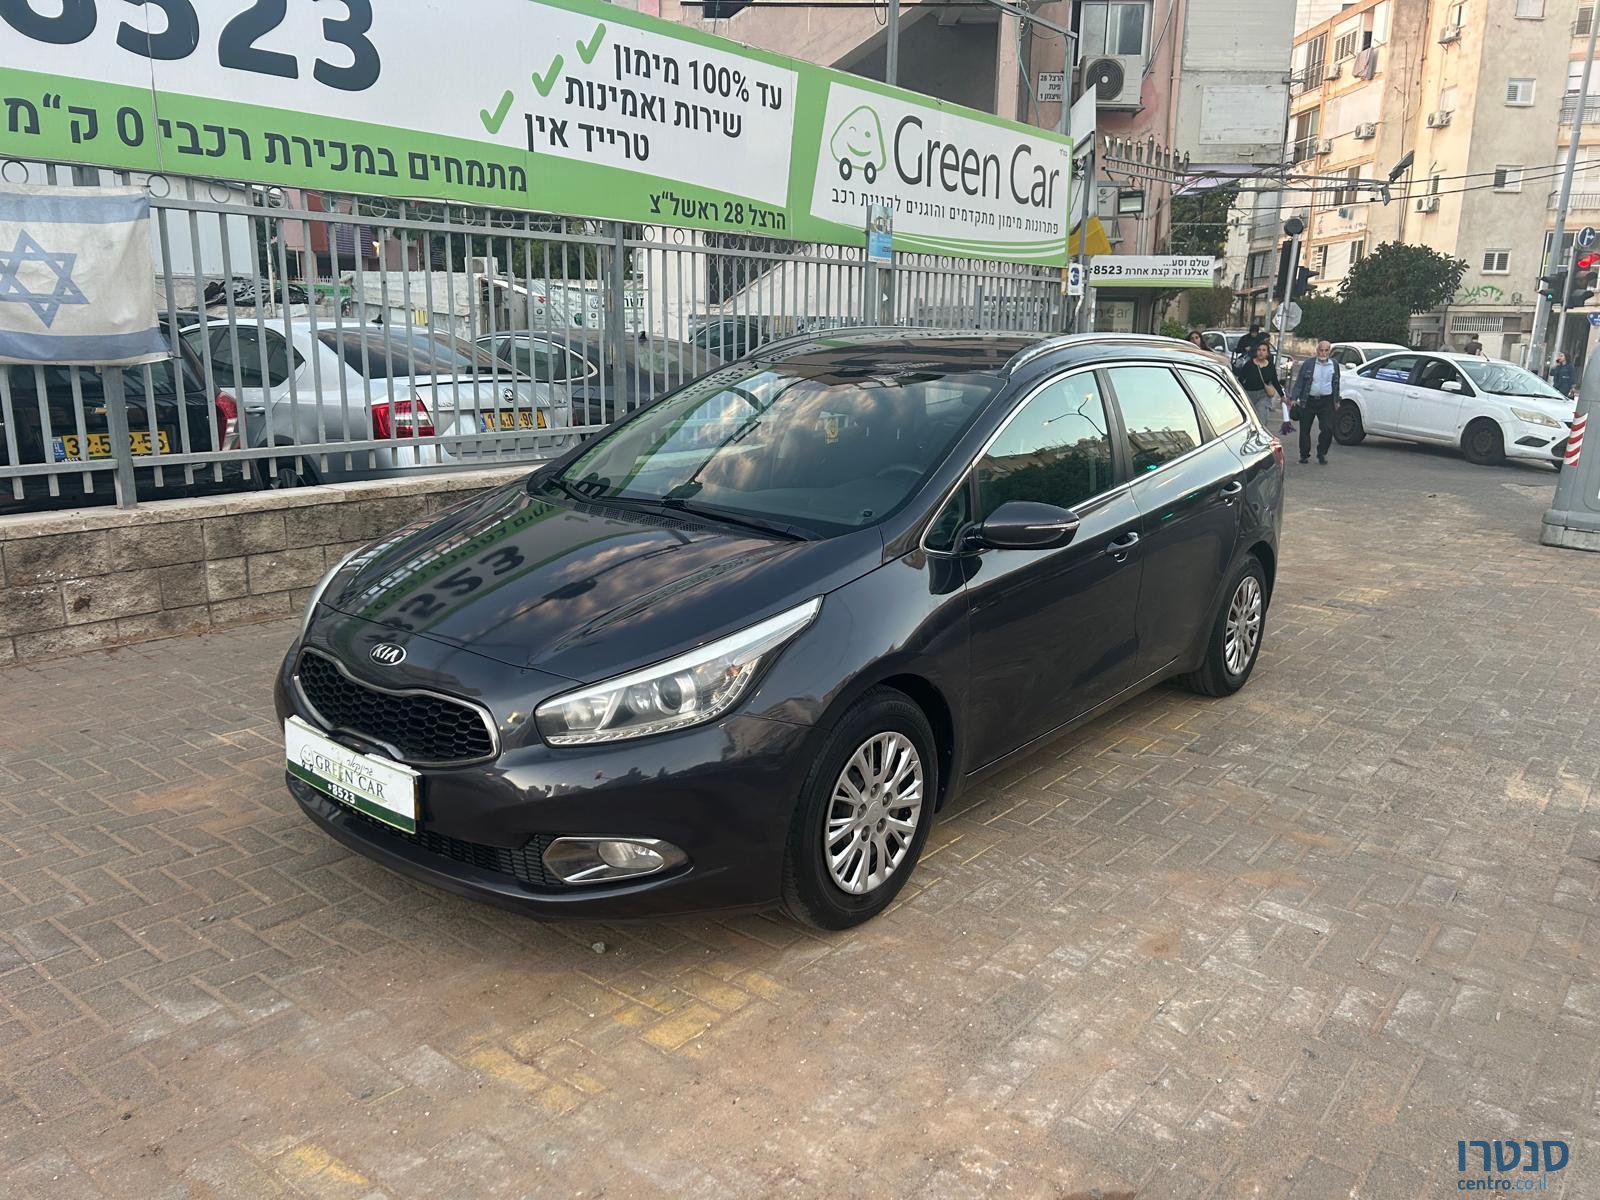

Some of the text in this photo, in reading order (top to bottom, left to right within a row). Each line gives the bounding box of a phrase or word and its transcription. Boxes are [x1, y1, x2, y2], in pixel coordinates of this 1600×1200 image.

[613, 43, 783, 110] עד 100% מימון
[564, 76, 742, 138] שירות ואמינות
[117, 106, 144, 147] 0
[524, 113, 650, 162] טרייד אין
[159, 118, 251, 160] רכבי
[265, 131, 399, 179] במכירת
[893, 115, 1060, 209] Green Car
[408, 152, 528, 193] מתמחים
[832, 188, 855, 206] רכב
[906, 200, 945, 218] והוגנים
[724, 201, 745, 225] 28
[749, 203, 787, 231] הרצל
[949, 207, 995, 227] מתקדמים
[998, 214, 1022, 230] מימון
[1024, 218, 1059, 235] פתרונות
[1124, 268, 1149, 276] אחרת
[1151, 268, 1170, 277] קצת
[1171, 268, 1183, 276] זה
[1183, 267, 1209, 276] אצלנו
[371, 644, 400, 663] KIA
[315, 755, 354, 784] GREEN
[358, 776, 385, 798] CAR
